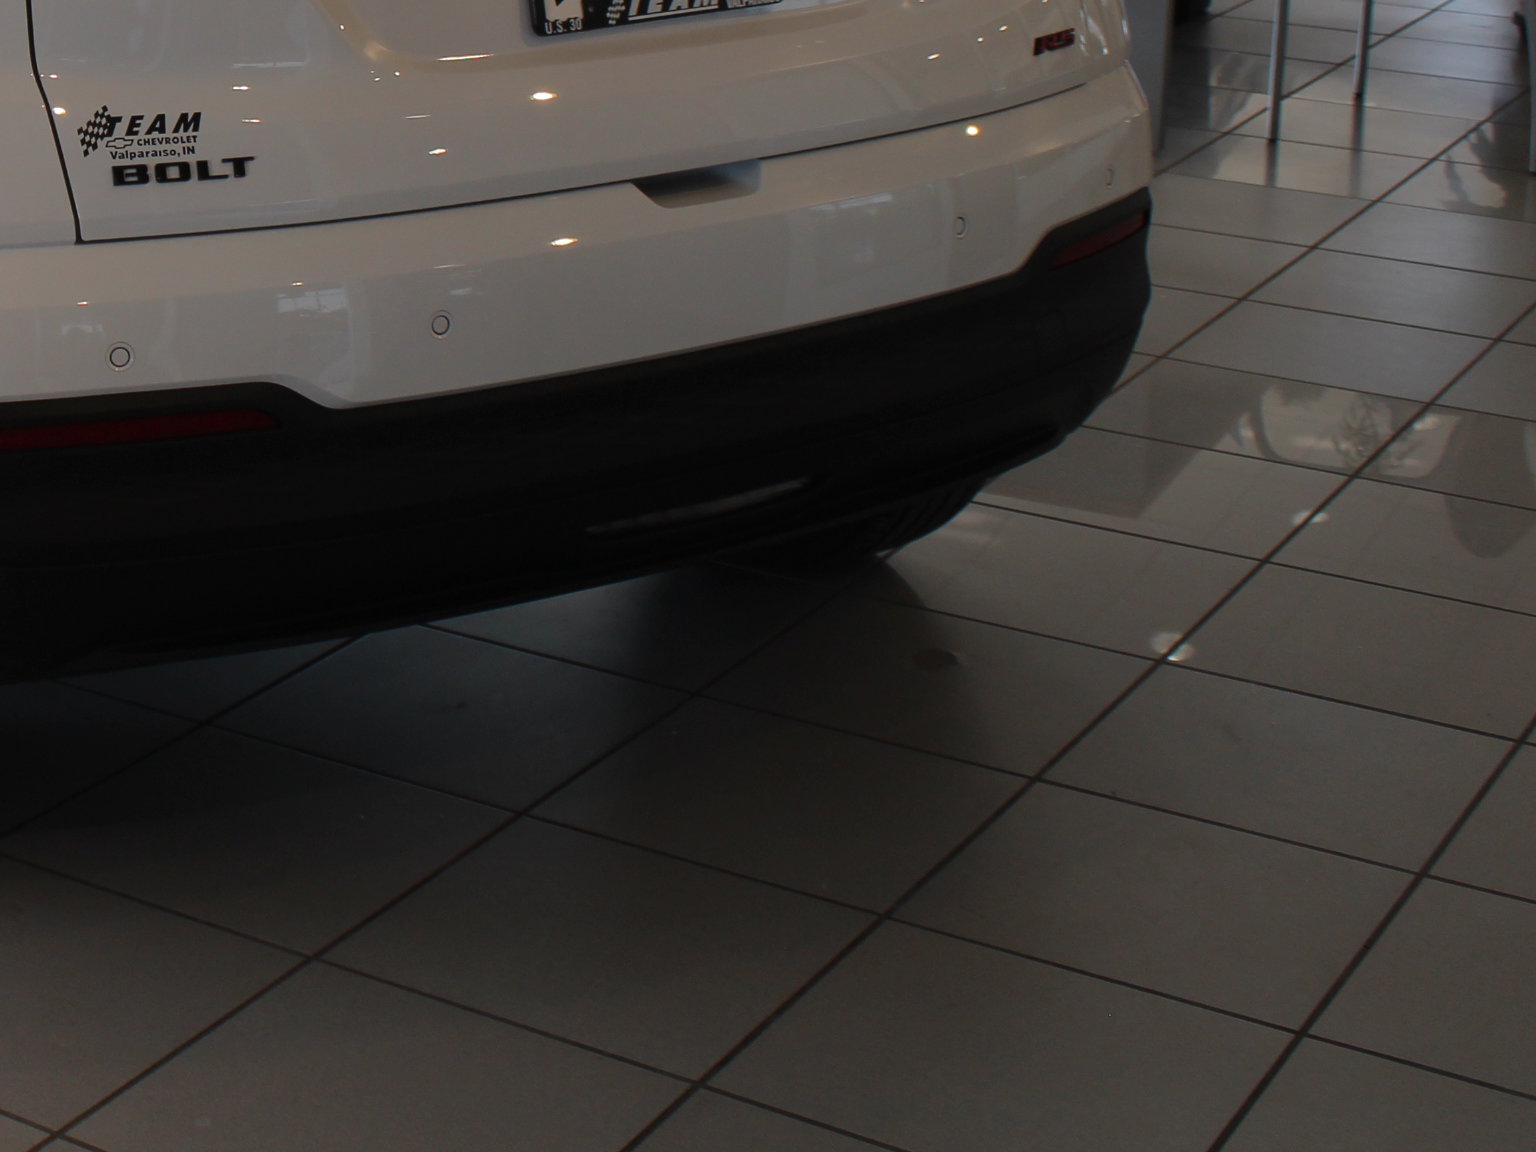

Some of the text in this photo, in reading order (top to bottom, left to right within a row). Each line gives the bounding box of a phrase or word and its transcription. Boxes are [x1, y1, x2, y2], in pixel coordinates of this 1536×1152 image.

[545, 18, 582, 35] U.S. 30
[105, 111, 202, 138] TEAM
[137, 135, 198, 147] CHEVROLET
[110, 146, 196, 160] Valparaiso, IN
[111, 156, 256, 186] BOLT
